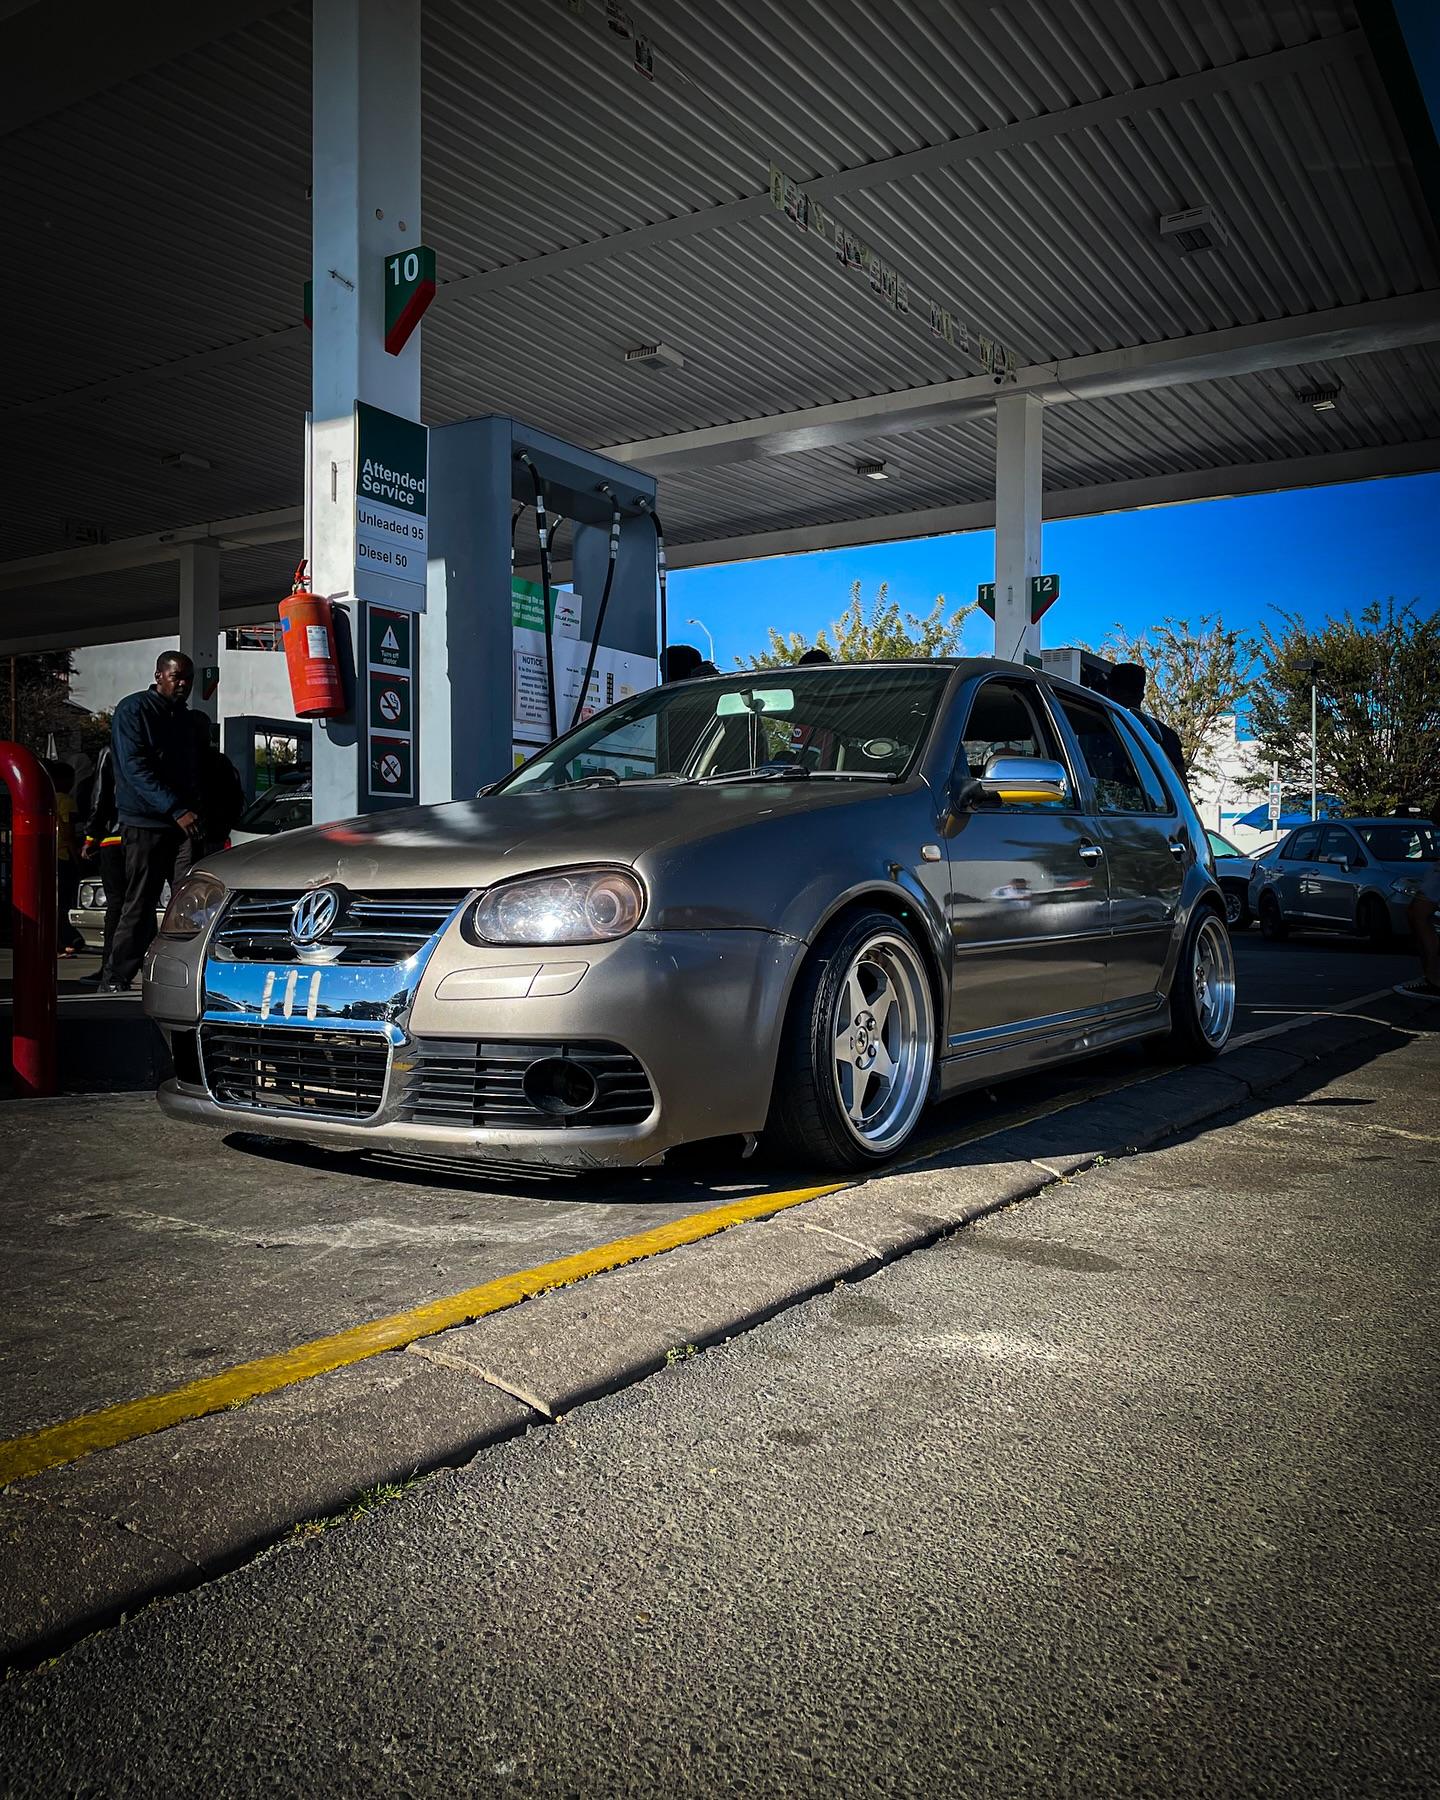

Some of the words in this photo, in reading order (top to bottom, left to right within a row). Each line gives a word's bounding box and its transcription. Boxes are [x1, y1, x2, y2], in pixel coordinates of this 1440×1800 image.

[390, 253, 419, 286] 10
[362, 458, 425, 493] Attended
[362, 475, 415, 505] Service
[358, 510, 409, 536] Unleaded
[411, 528, 424, 540] 95
[359, 543, 392, 564] Diesel
[395, 554, 408, 567] 50
[1034, 577, 1052, 592] 12
[381, 650, 392, 658] Turn
[522, 656, 544, 667] NOTICE
